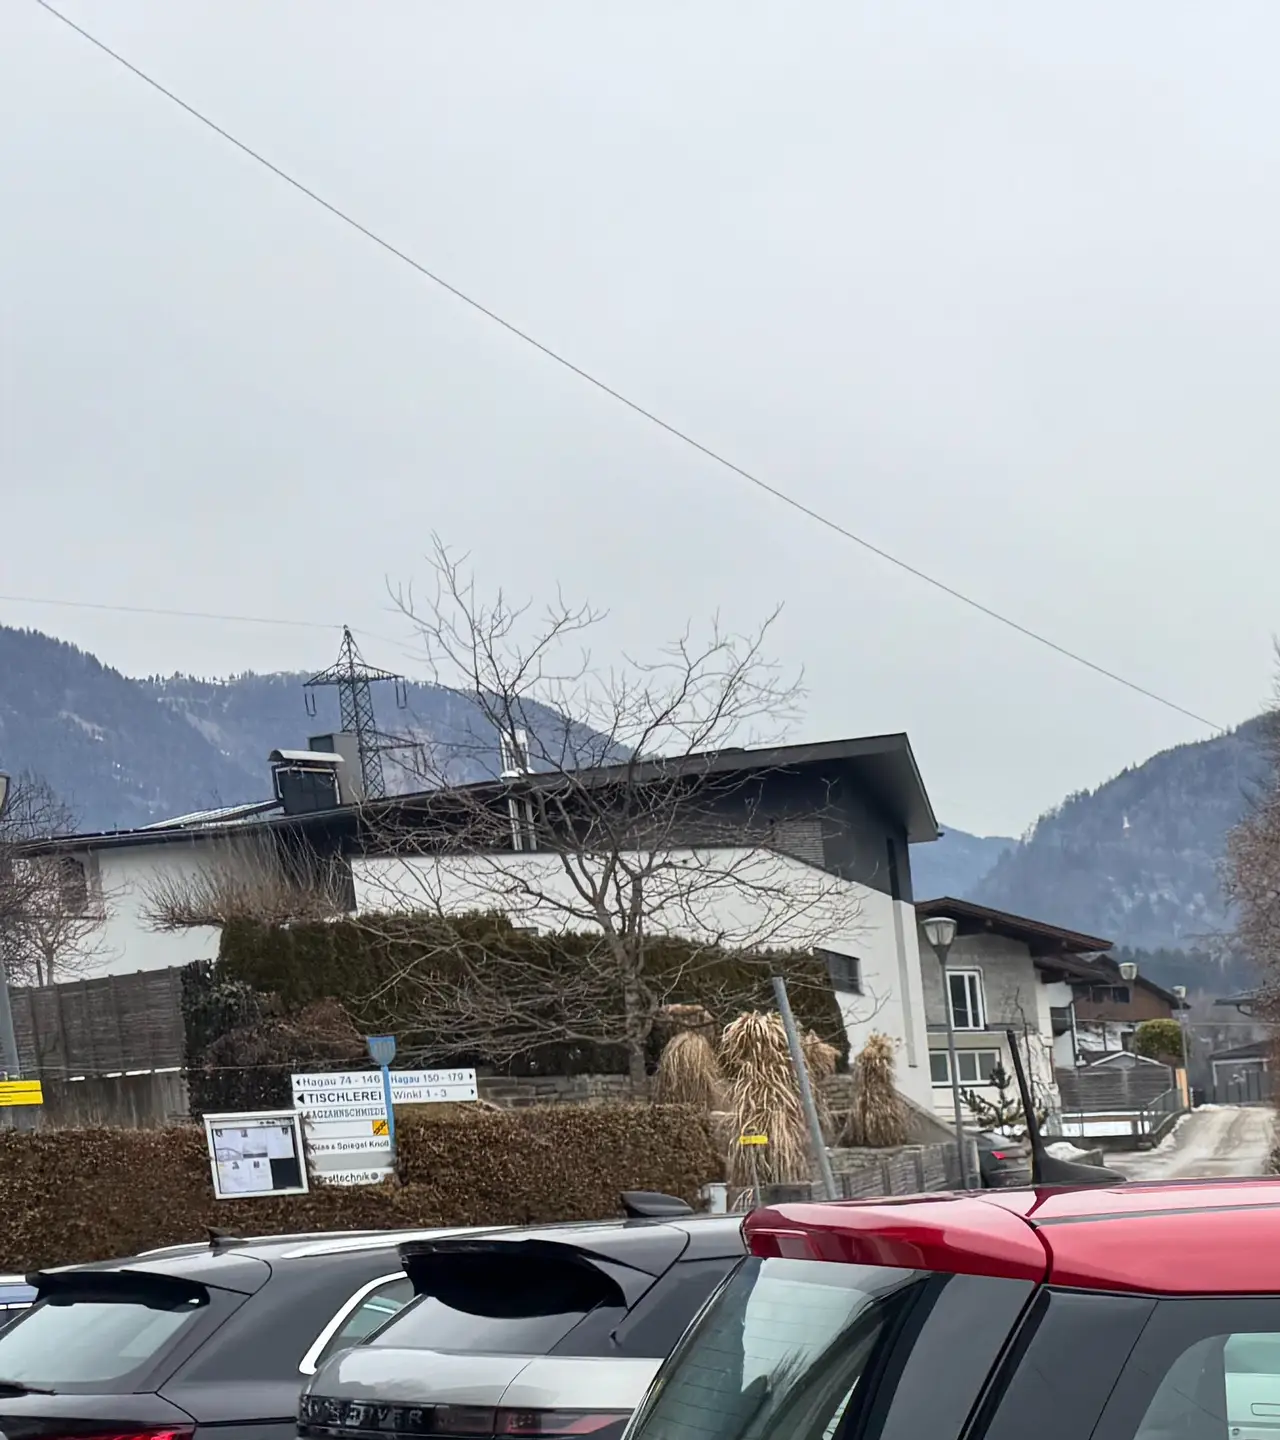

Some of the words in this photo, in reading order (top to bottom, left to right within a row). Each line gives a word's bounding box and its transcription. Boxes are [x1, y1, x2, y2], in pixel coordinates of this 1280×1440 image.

[302, 1077, 337, 1087] Hagau
[340, 1075, 352, 1085] 74
[362, 1074, 381, 1084] 146
[391, 1075, 420, 1084] Hagau
[423, 1073, 440, 1082] 150
[448, 1072, 464, 1081] 179
[307, 1091, 382, 1103] TISCHLEREI
[393, 1090, 422, 1099] Winkl
[426, 1089, 431, 1098] 1
[441, 1088, 447, 1097] 3
[337, 1141, 367, 1150] Spiegel
